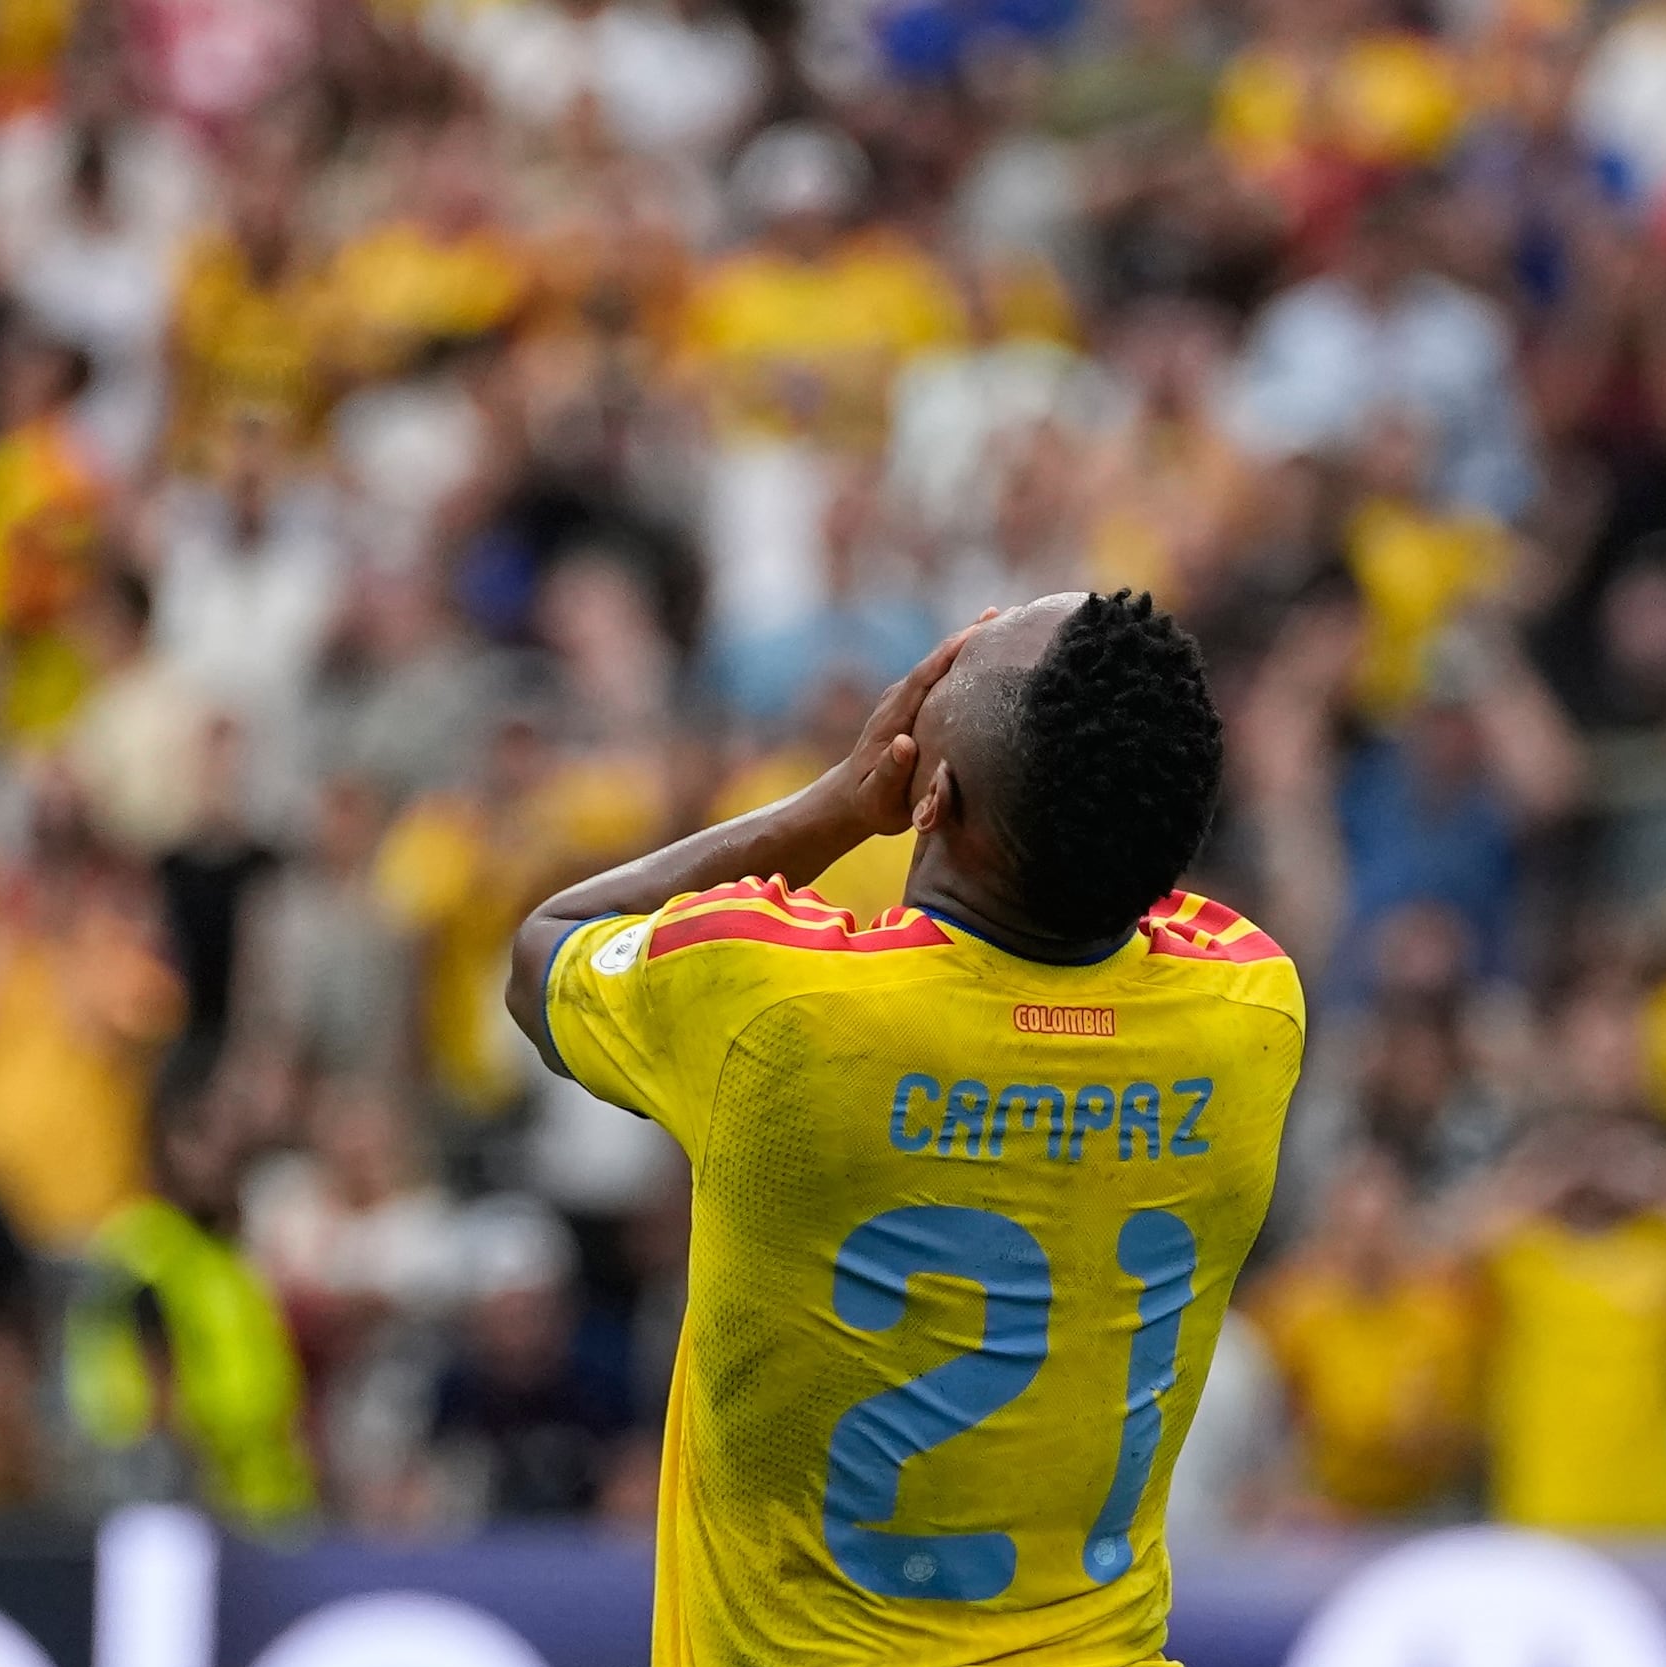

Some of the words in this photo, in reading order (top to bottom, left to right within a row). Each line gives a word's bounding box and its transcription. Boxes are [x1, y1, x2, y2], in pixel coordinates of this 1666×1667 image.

[1014, 1004, 1115, 1036] COLOMBIA
[889, 1072, 1214, 1161] CAMPAZ
[823, 1205, 1197, 1601] 21
